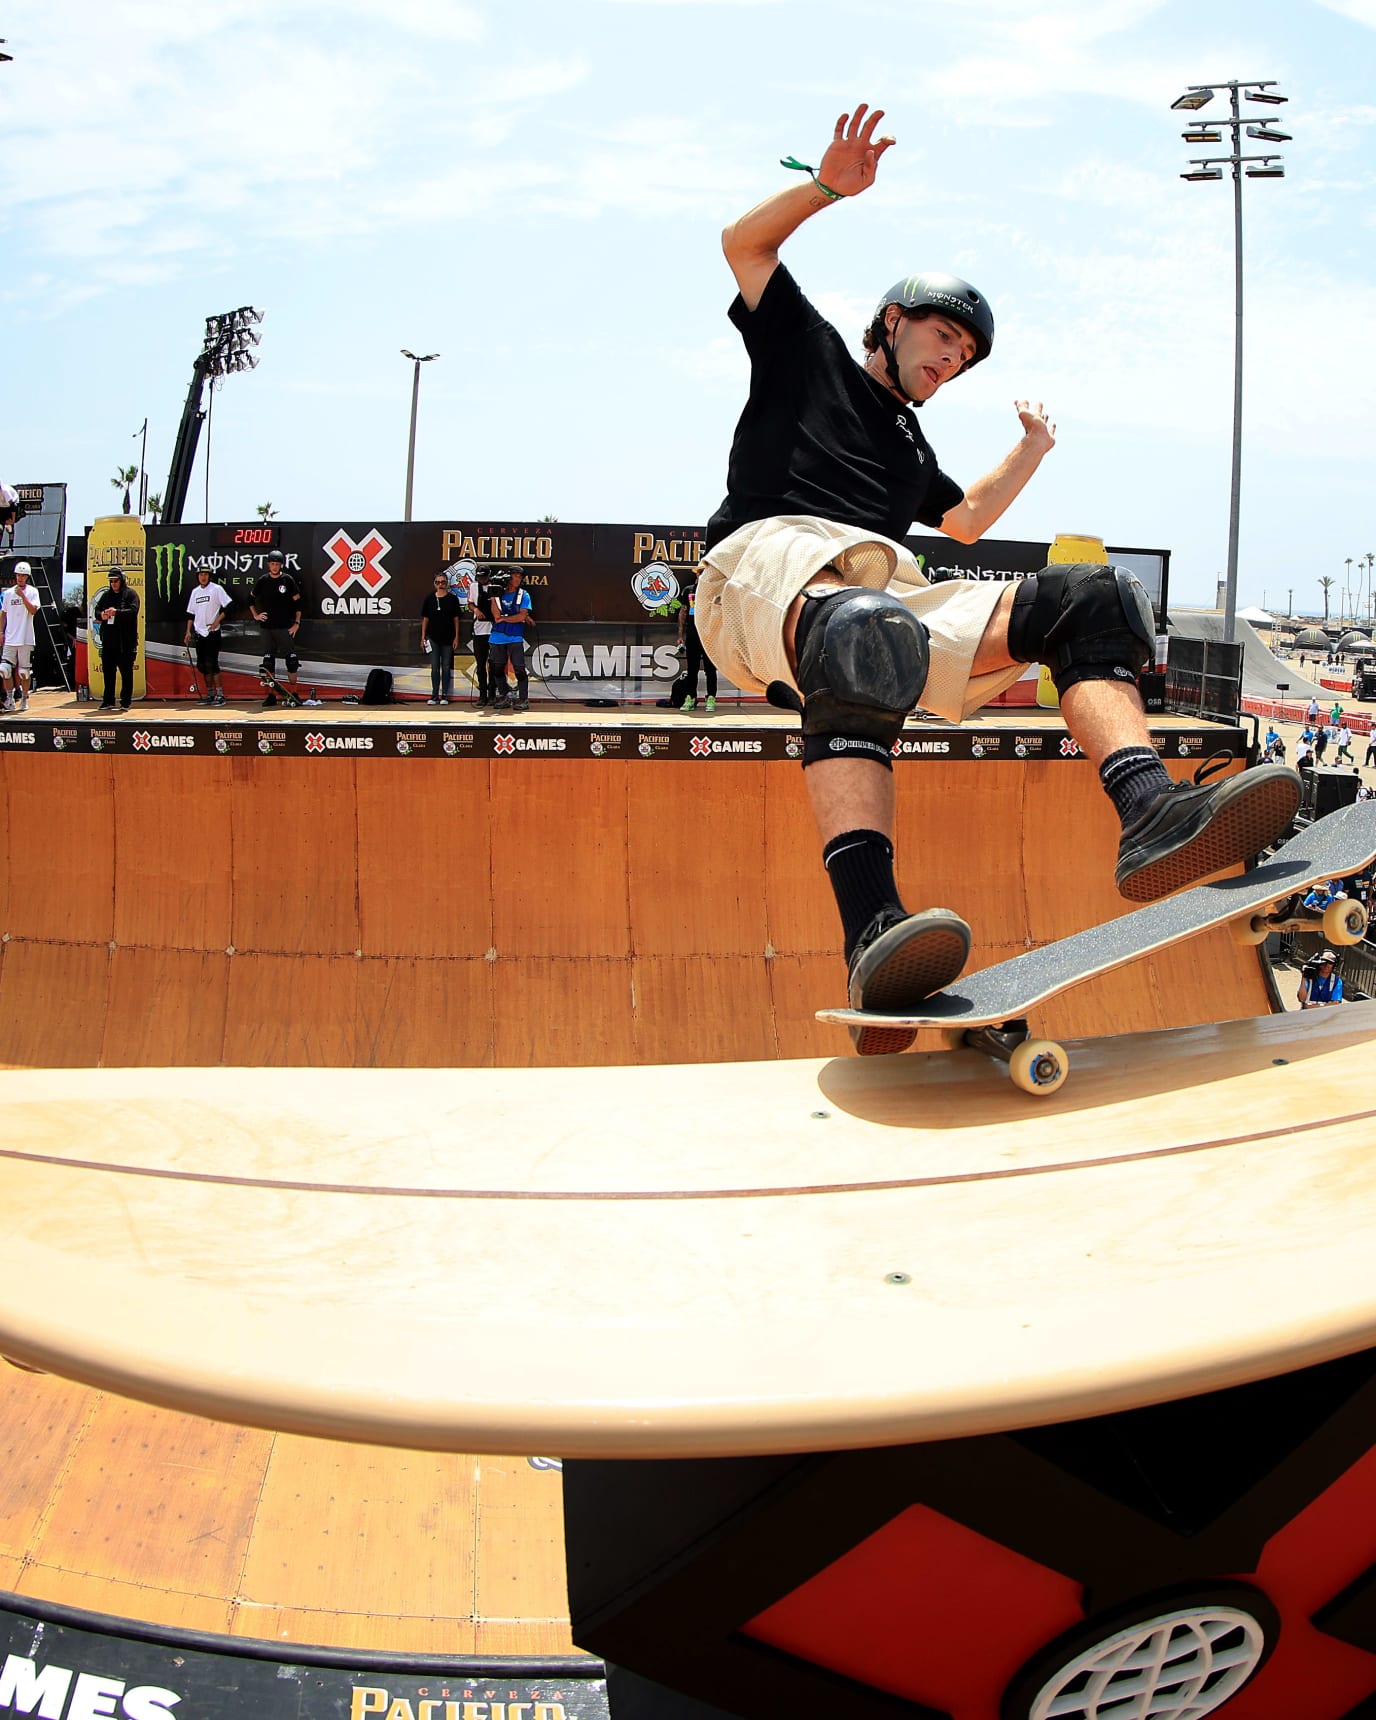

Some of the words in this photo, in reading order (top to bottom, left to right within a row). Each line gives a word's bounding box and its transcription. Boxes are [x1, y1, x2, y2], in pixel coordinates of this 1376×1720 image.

[234, 529, 272, 543] 20:00
[476, 527, 553, 535] CERVEZA
[441, 529, 553, 561] PACIFICO
[632, 532, 706, 564] PACIF
[187, 550, 302, 574] MONSTR
[217, 577, 255, 585] NER
[523, 575, 549, 586] ARA
[321, 597, 393, 616] GAMES
[531, 643, 681, 679] GAMES
[0, 731, 36, 745] GAMES
[52, 728, 78, 737] PACIFICO
[90, 729, 116, 738] PACIFICO
[214, 730, 243, 740] PACIFICO
[257, 730, 286, 740] PACIFICO
[396, 731, 427, 741] PACIFICO
[442, 732, 474, 742] PACIFICO
[590, 733, 622, 742] PACIFICO
[151, 735, 195, 748] GAMES
[325, 737, 374, 750] GAMES
[638, 734, 670, 743] PACIFICO
[785, 734, 803, 744] PACI
[971, 735, 1001, 745] PACIFICO
[1014, 736, 1043, 745] PACIFICO
[1178, 736, 1203, 744] PACIFICO
[515, 738, 567, 751] GAMES
[711, 740, 763, 753] GAMES
[902, 740, 950, 754] GAMES
[0, 1653, 183, 1720] MES
[417, 1686, 564, 1700] CERVEZA
